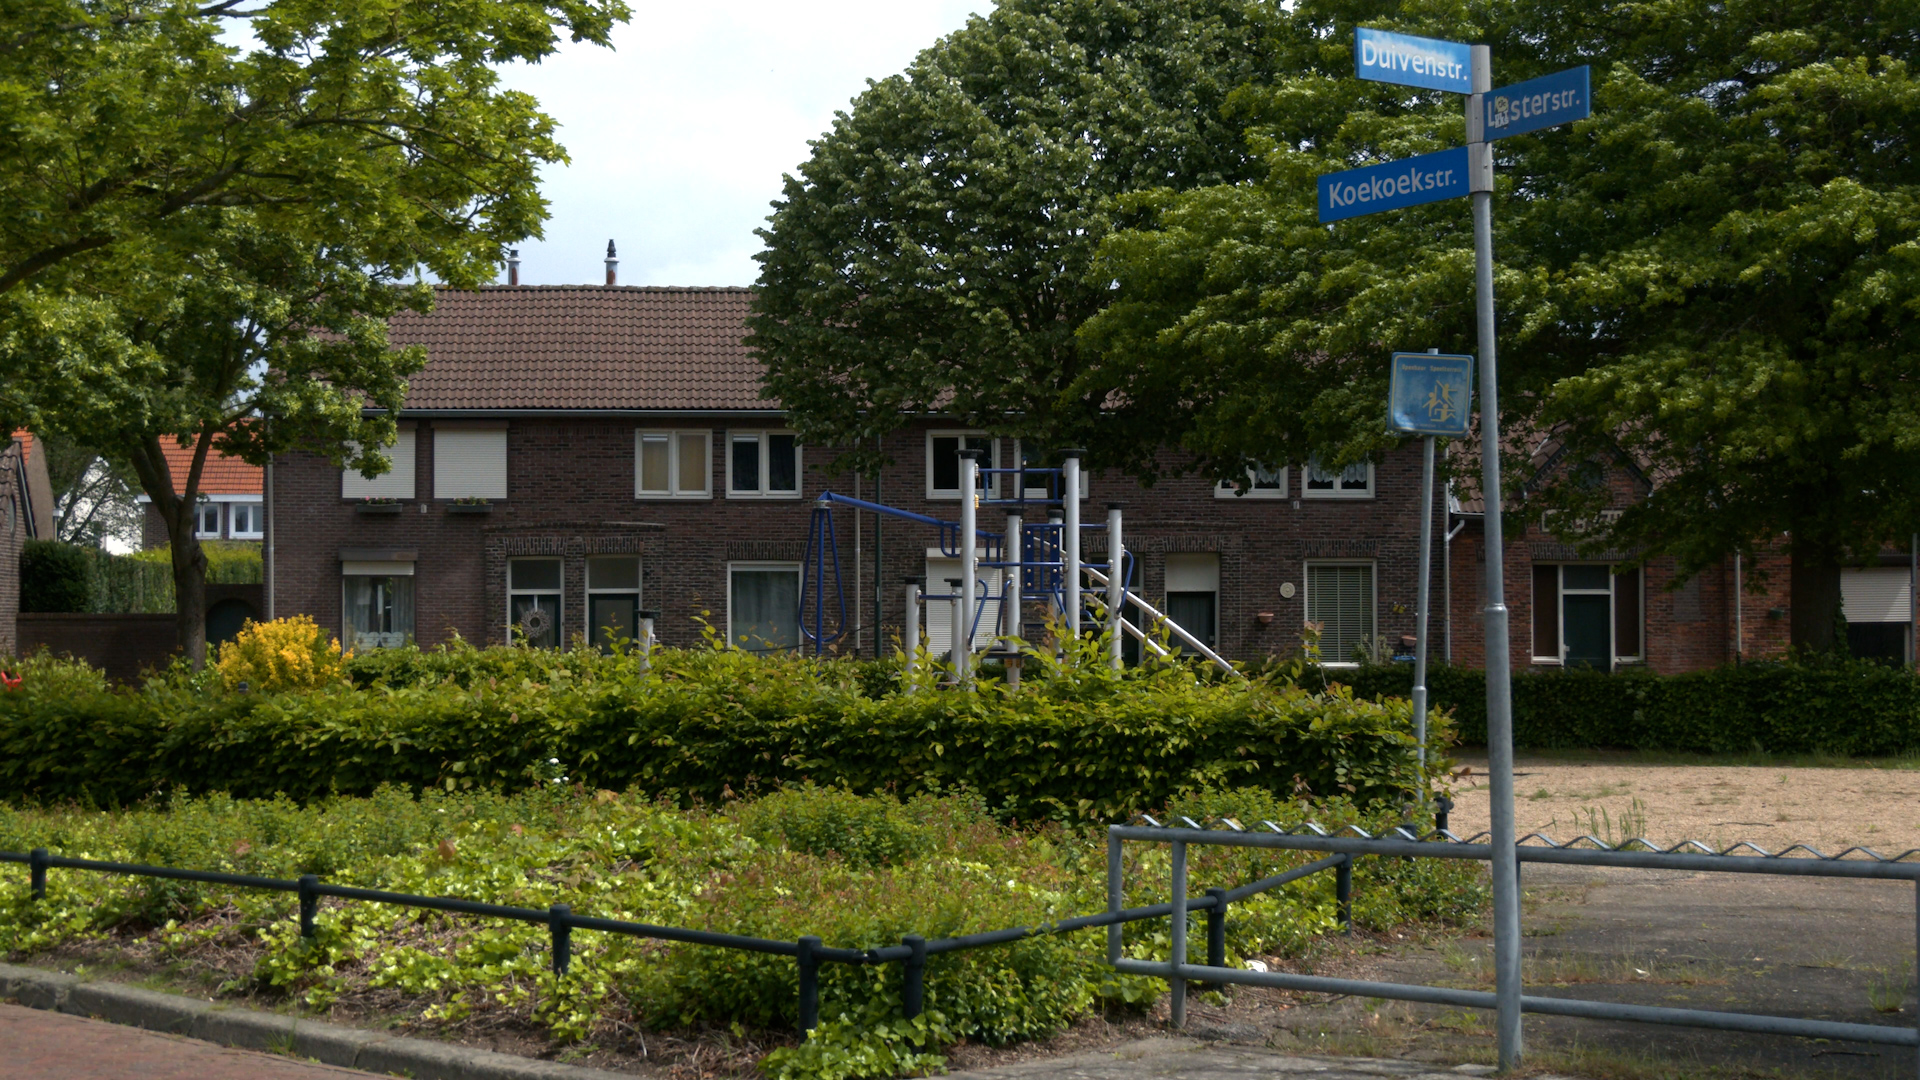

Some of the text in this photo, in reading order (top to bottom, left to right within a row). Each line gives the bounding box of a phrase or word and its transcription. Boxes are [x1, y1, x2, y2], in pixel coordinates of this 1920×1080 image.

[1361, 39, 1468, 81] Duivenstr.
[1487, 89, 1580, 127] Lsterstr.
[1328, 167, 1457, 209] Koekoekstr.
